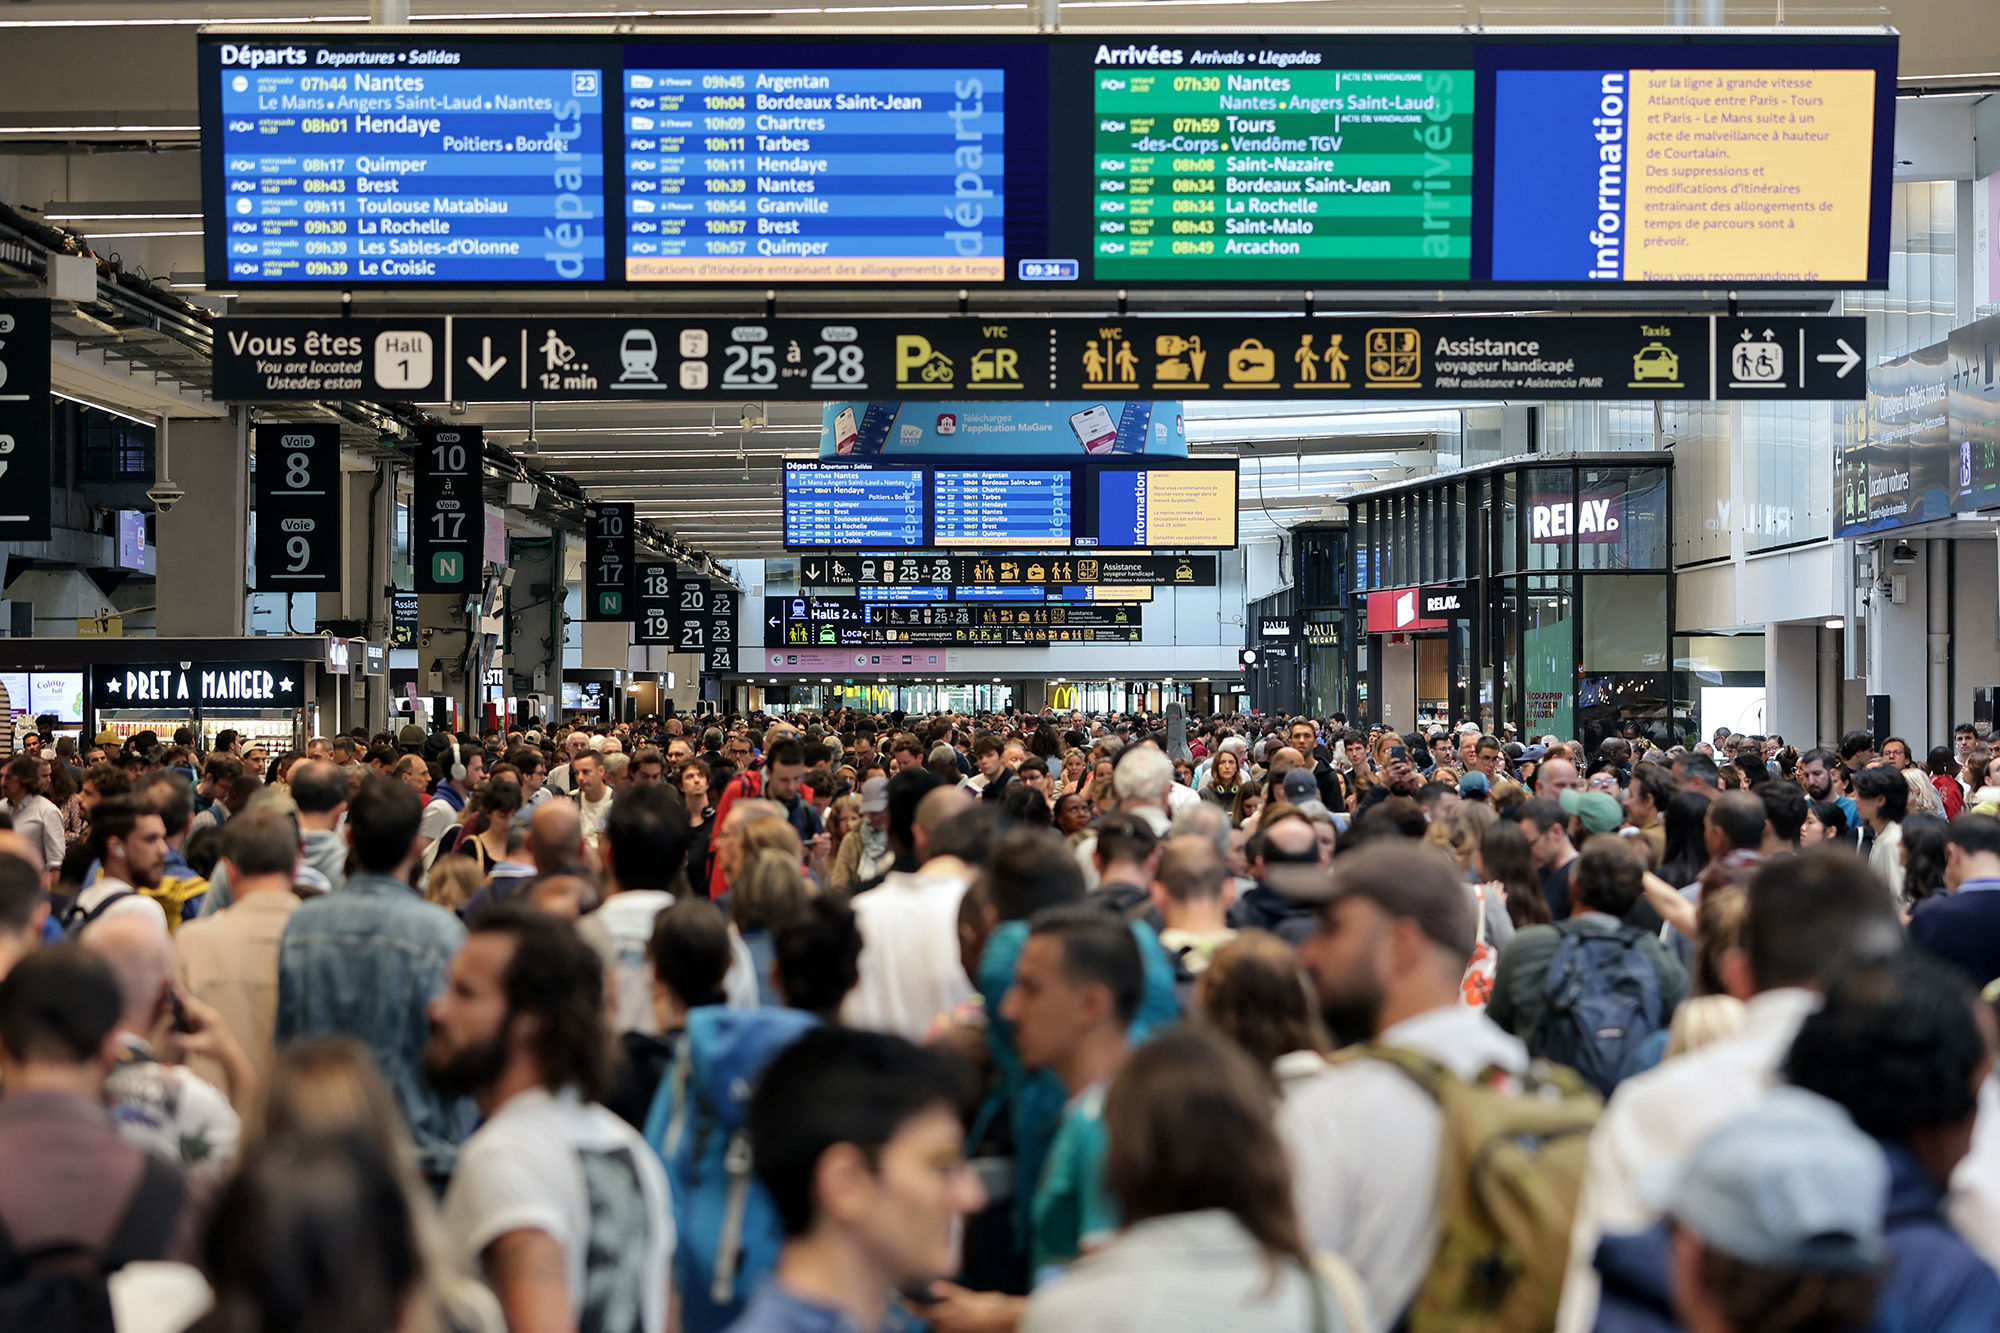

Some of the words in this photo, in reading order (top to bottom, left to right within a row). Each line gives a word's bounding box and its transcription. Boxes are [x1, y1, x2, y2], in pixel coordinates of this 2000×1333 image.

[220, 45, 307, 69] Départs
[316, 50, 395, 67] Departures
[408, 50, 460, 64] Salidas
[1094, 45, 1183, 65] Arrivées
[1191, 51, 1245, 65] Arrivals
[1258, 51, 1322, 67] Llegadas
[300, 77, 348, 91] 07h44
[354, 75, 424, 92] Nantes
[755, 74, 829, 92] Argentan
[1173, 77, 1221, 91] 07h30
[1227, 75, 1291, 91] Nantes
[258, 96, 278, 110] Le
[395, 95, 482, 110] Saint-Laud
[756, 95, 832, 110] Bordeaux
[836, 94, 922, 111] Saint-Jean
[1220, 96, 1276, 110] Nantes
[1289, 96, 1344, 113] Angers
[1347, 95, 1434, 110] Saint-Laud
[1648, 95, 1710, 108] Atlantique
[302, 119, 348, 133] 08h01
[356, 116, 441, 137] Hendaye
[755, 115, 825, 131] Chartres
[1173, 118, 1220, 132] 07h59
[1226, 116, 1276, 132] Tours
[1694, 129, 1769, 141] malveillance
[756, 136, 810, 152] Tarbes
[1131, 136, 1219, 154] -des-Corps
[1231, 136, 1307, 152] Vendôme
[1309, 136, 1343, 151] TGV
[303, 159, 345, 172] 08h17
[356, 157, 426, 174] Quimper
[757, 157, 827, 176] Hendaye
[944, 78, 994, 257] départs
[1226, 158, 1334, 173] Saint-Nazaire
[1412, 74, 1453, 257] arrivées
[1671, 166, 1749, 179] suppressions
[1589, 74, 1624, 279] information
[303, 179, 346, 193] 08h43
[357, 178, 399, 193] Brest
[544, 100, 593, 278] départs
[757, 178, 815, 193] Nantes
[1226, 178, 1301, 193] Bordeaux
[1305, 177, 1391, 194] Saint-Jean
[1645, 183, 1728, 194] modifications
[304, 200, 346, 213] 09h11
[357, 199, 430, 214] Toulouse
[434, 199, 508, 214] Matabiau
[757, 198, 829, 213] Granville
[1226, 199, 1245, 213] La
[1249, 198, 1318, 214] Rochelle
[1734, 200, 1815, 215] allongements
[304, 220, 347, 234] 09h30
[358, 219, 377, 234] La
[381, 219, 450, 234] Rochelle
[757, 219, 800, 234] Brest
[1226, 219, 1313, 234] Saint-Malo
[305, 241, 347, 254] 09h39
[359, 240, 386, 255] Les
[390, 239, 519, 255] Sables-d'Olonne
[757, 239, 828, 257] Quimper
[1225, 239, 1300, 255] Arcachon
[305, 261, 348, 275] 09h39
[359, 261, 379, 275] Le
[382, 260, 436, 276] Croisic
[983, 327, 1007, 338] VTC
[1099, 328, 1122, 339] WC
[1641, 325, 1670, 337] Taxis
[228, 331, 296, 356] Vous
[304, 331, 362, 356] êtes
[386, 339, 422, 352] Hall
[1435, 337, 1539, 356] Assistance
[256, 361, 276, 374] You
[279, 362, 308, 374] are
[310, 360, 362, 374] located
[398, 360, 410, 381] 1
[723, 346, 777, 383] 25
[812, 346, 864, 383] 28
[1435, 360, 1499, 375] voyageur
[1503, 358, 1575, 373] handicapé
[267, 377, 321, 390] Ustedes
[324, 378, 362, 389] estan
[540, 374, 559, 389] 12
[564, 374, 598, 390] min
[1462, 377, 1514, 388] assistance
[1525, 377, 1576, 388] Asistencia
[1880, 393, 1903, 421] Consignes
[1910, 383, 1926, 414] Objets
[1926, 377, 1946, 405] trouvés
[963, 414, 1012, 423] Téléchargez
[961, 423, 1016, 433] l'application
[1018, 423, 1053, 431] MaGare
[285, 437, 310, 447] Voie
[439, 434, 458, 442] Voie
[432, 446, 465, 471] 10
[1984, 442, 1995, 469] BUS
[286, 453, 310, 488] 8
[834, 487, 864, 495] Hendaye
[1869, 473, 1888, 497] Location
[1888, 469, 1909, 492] voitures
[439, 501, 458, 509] Voie
[1134, 472, 1146, 545] information
[285, 520, 310, 530] Voie
[432, 513, 465, 537] 17
[599, 517, 622, 535] 10
[287, 536, 310, 572] 9
[441, 559, 456, 576] N
[598, 565, 622, 582] 17
[901, 566, 919, 579] 25
[932, 566, 951, 579] 28
[1103, 563, 1141, 571] Assistance
[644, 576, 668, 594] 18
[604, 597, 617, 609] N
[681, 592, 703, 608] 20
[712, 600, 730, 613] 22
[811, 610, 840, 620] Halls
[842, 610, 849, 619] 2
[935, 613, 947, 622] 25
[956, 613, 968, 622] 28
[644, 618, 668, 636] 19
[712, 627, 730, 640] 23
[1306, 624, 1338, 636] PAUL
[682, 628, 703, 645] 21
[712, 654, 730, 666] 24
[37, 680, 66, 689] Colour
[127, 671, 171, 699] PRET
[202, 670, 274, 699] MANGER
